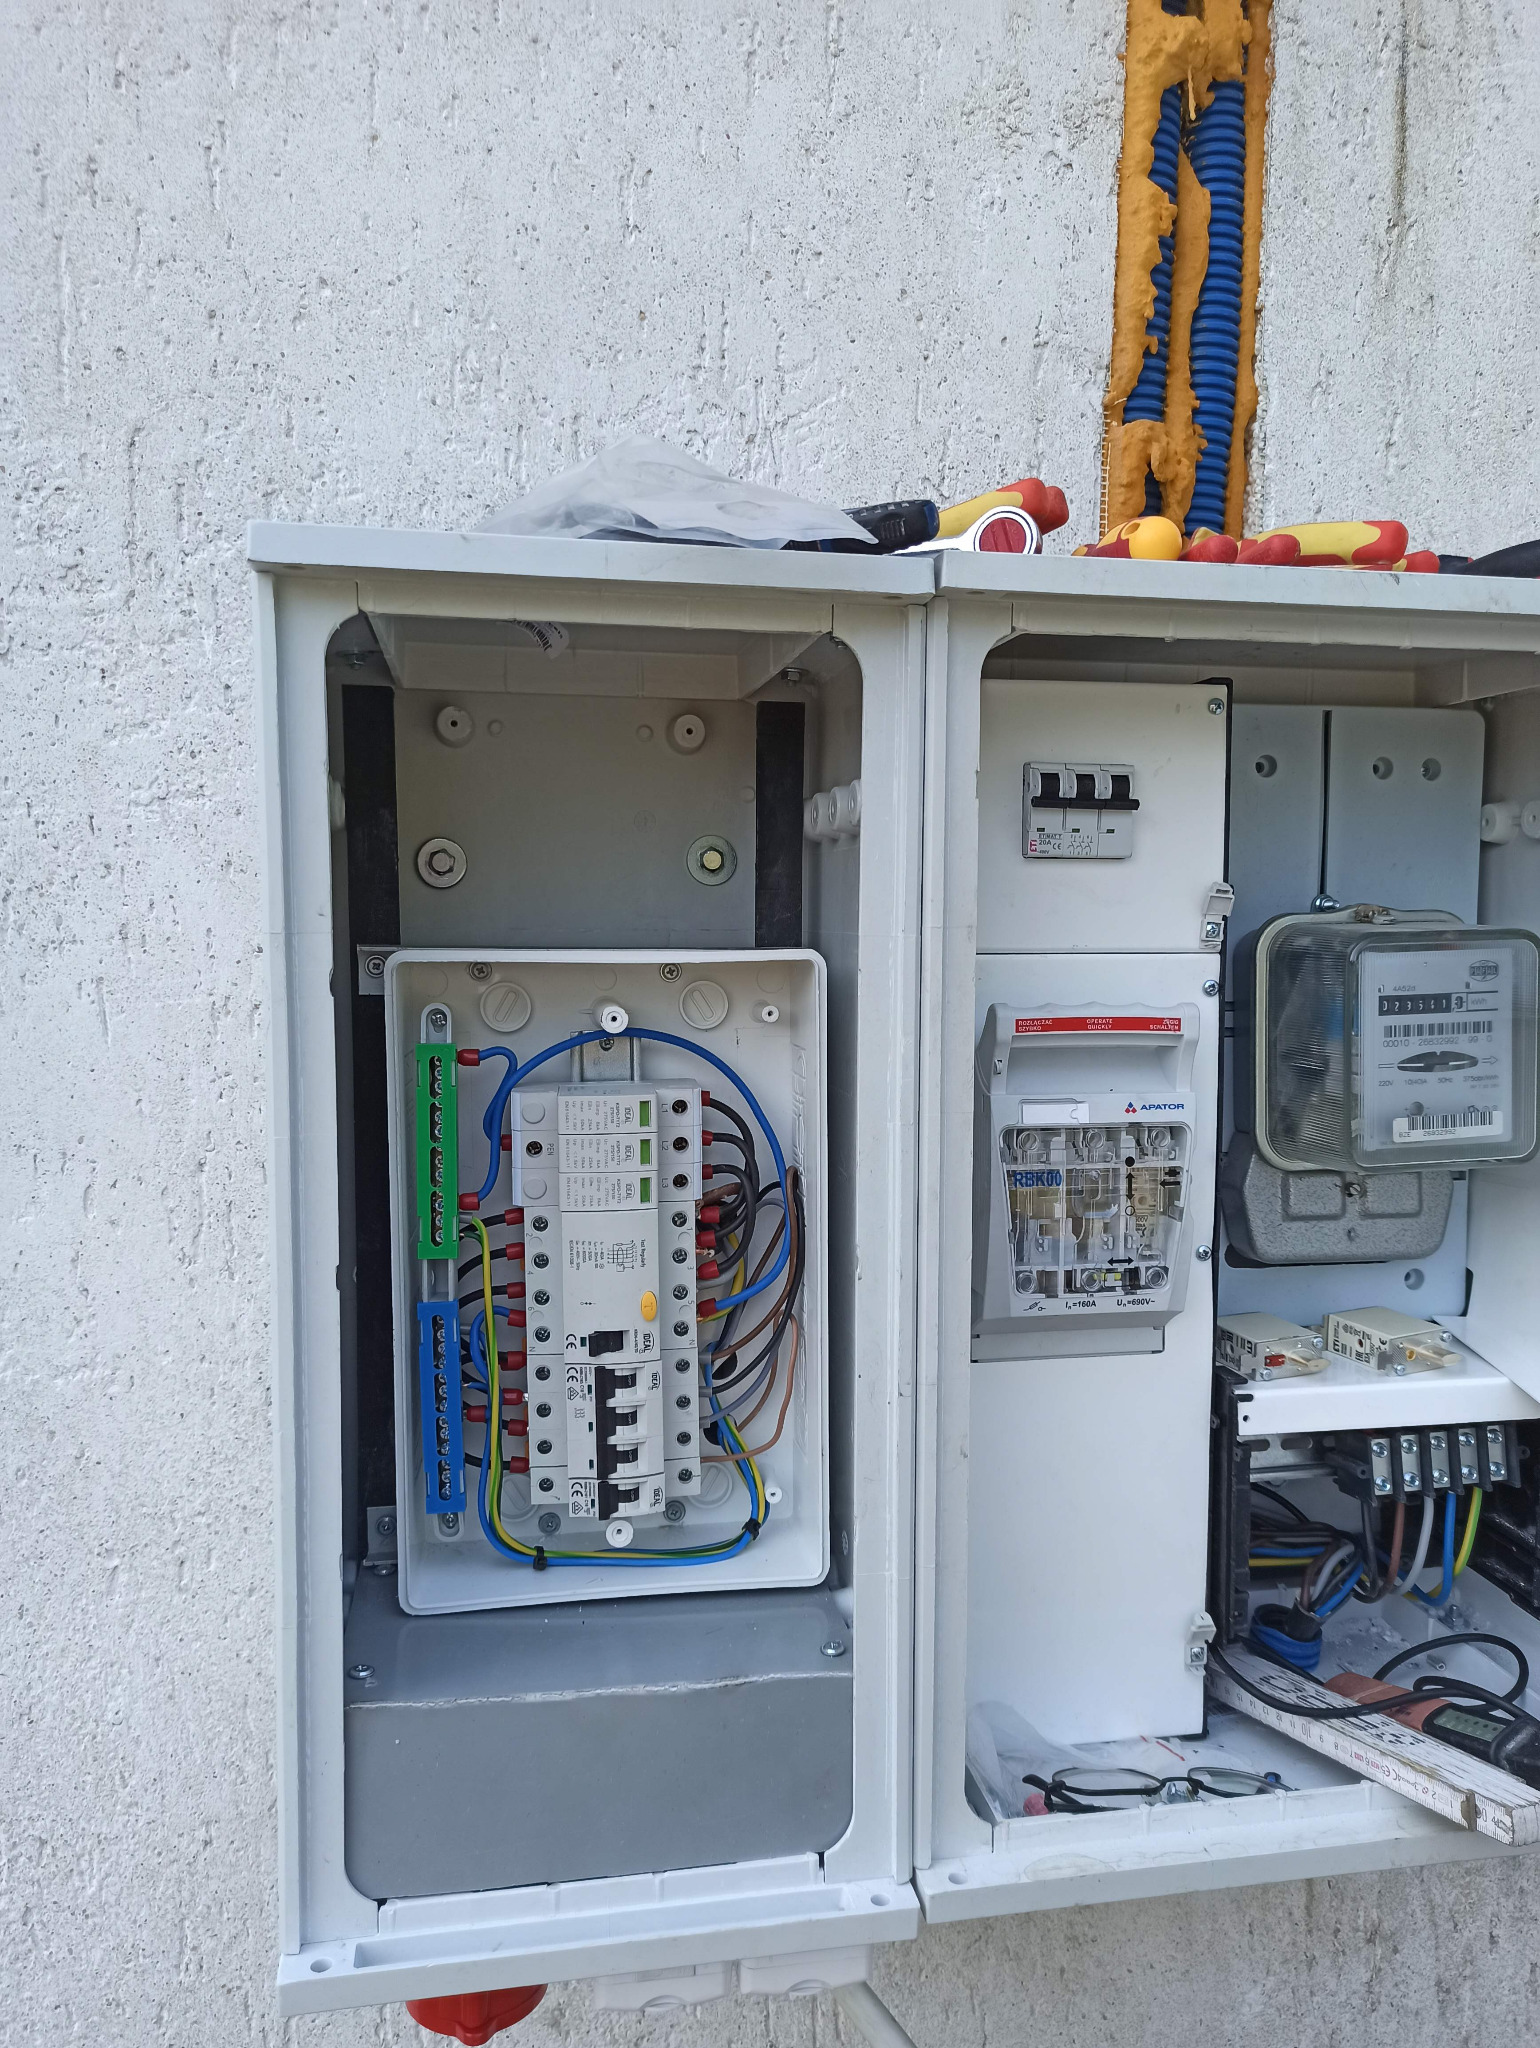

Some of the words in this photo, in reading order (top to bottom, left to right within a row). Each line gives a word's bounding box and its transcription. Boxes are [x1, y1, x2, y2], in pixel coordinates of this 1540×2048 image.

[661, 1104, 668, 1113] L1
[624, 1107, 632, 1124] IDEAL
[662, 1141, 669, 1150] L2
[662, 1178, 669, 1188] L3
[1014, 1171, 1062, 1188] RBK00
[1334, 1742, 1338, 1750] 8
[1432, 1791, 1436, 1799] 2
